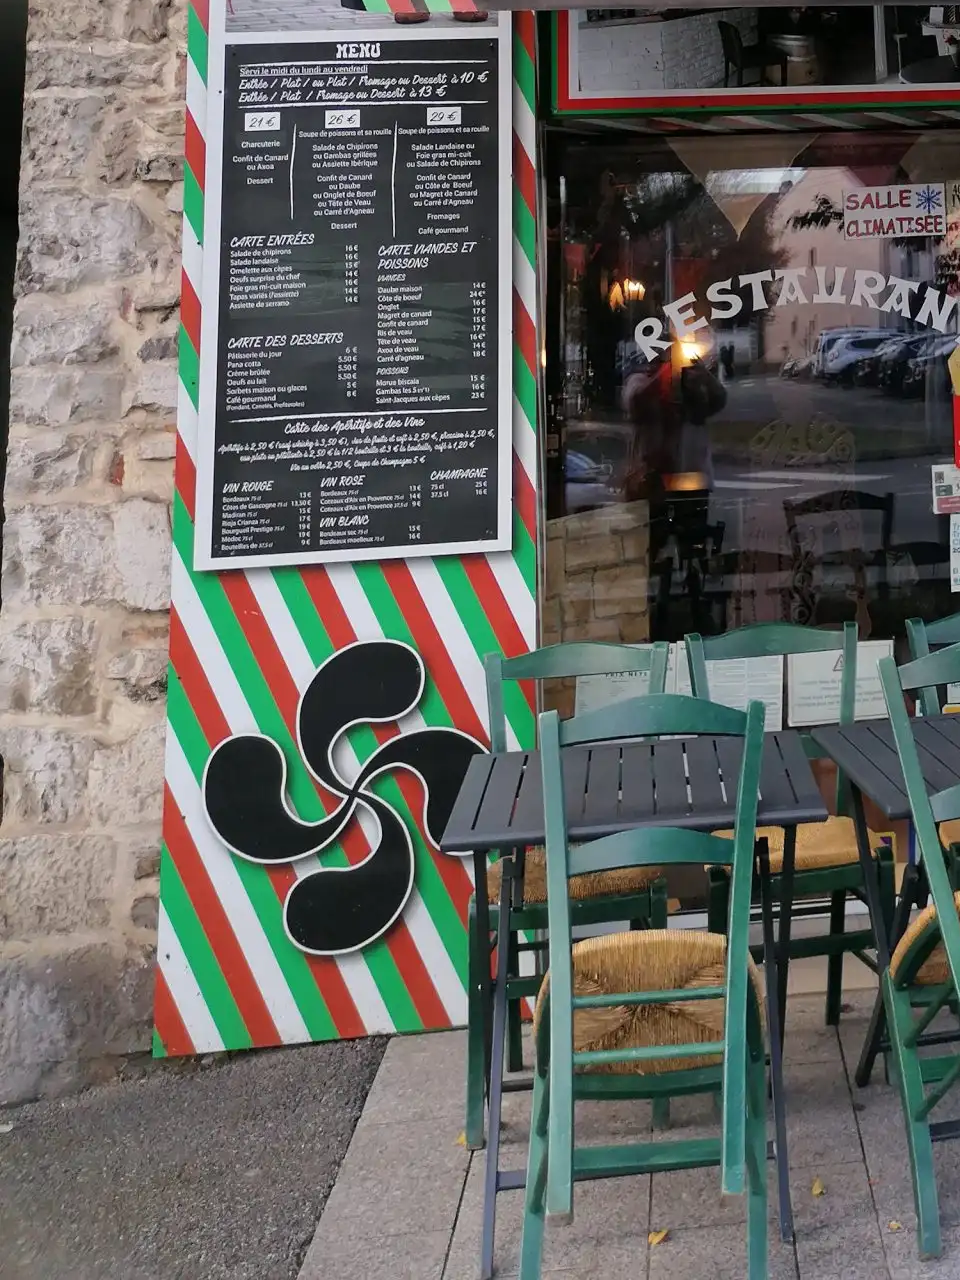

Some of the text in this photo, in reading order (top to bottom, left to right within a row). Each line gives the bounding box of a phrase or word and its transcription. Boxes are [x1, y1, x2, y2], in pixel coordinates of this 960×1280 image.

[335, 42, 381, 58] MENU
[240, 67, 260, 76] Servi
[262, 66, 268, 75] le
[270, 66, 288, 74] midi
[290, 66, 300, 74] du
[302, 65, 321, 74] lundi
[335, 65, 368, 74] vendredi
[239, 78, 268, 90] Entrée
[280, 77, 301, 88] Plat
[326, 76, 347, 87] Plat
[359, 75, 397, 88] Fromage
[412, 74, 447, 85] Dessert
[460, 72, 474, 84] 10
[477, 71, 489, 83] €
[239, 91, 268, 102] Entrée
[280, 90, 301, 101] Plat
[316, 90, 355, 102] Fromage
[370, 88, 405, 98] Dessert
[418, 86, 432, 97] 13
[435, 85, 448, 97] €
[249, 116, 276, 127] 21 €
[328, 114, 357, 125] 26 €
[430, 111, 458, 122] 29 €
[346, 143, 378, 151] Chipirons
[353, 152, 377, 160] grillées
[323, 191, 345, 199] Onglet
[846, 190, 912, 210] SALLE
[435, 226, 469, 235] gourmand
[846, 215, 943, 237] CLIMATISEE
[230, 231, 314, 247] CARTE ENTRÉES
[378, 242, 477, 256] CARTE VIANDES ET
[377, 257, 429, 269] POISSONS
[227, 332, 343, 349] CARTE DES DESSERTS
[284, 422, 310, 434] Carte
[311, 421, 330, 432] des
[374, 419, 384, 428] et
[385, 417, 403, 428] des
[404, 417, 425, 427] Vins
[430, 468, 488, 480] CHAMPAGNE
[222, 480, 274, 493] VIN ROUGE
[320, 475, 365, 488] VIN ROSE
[319, 515, 370, 527] VIN BLANC
